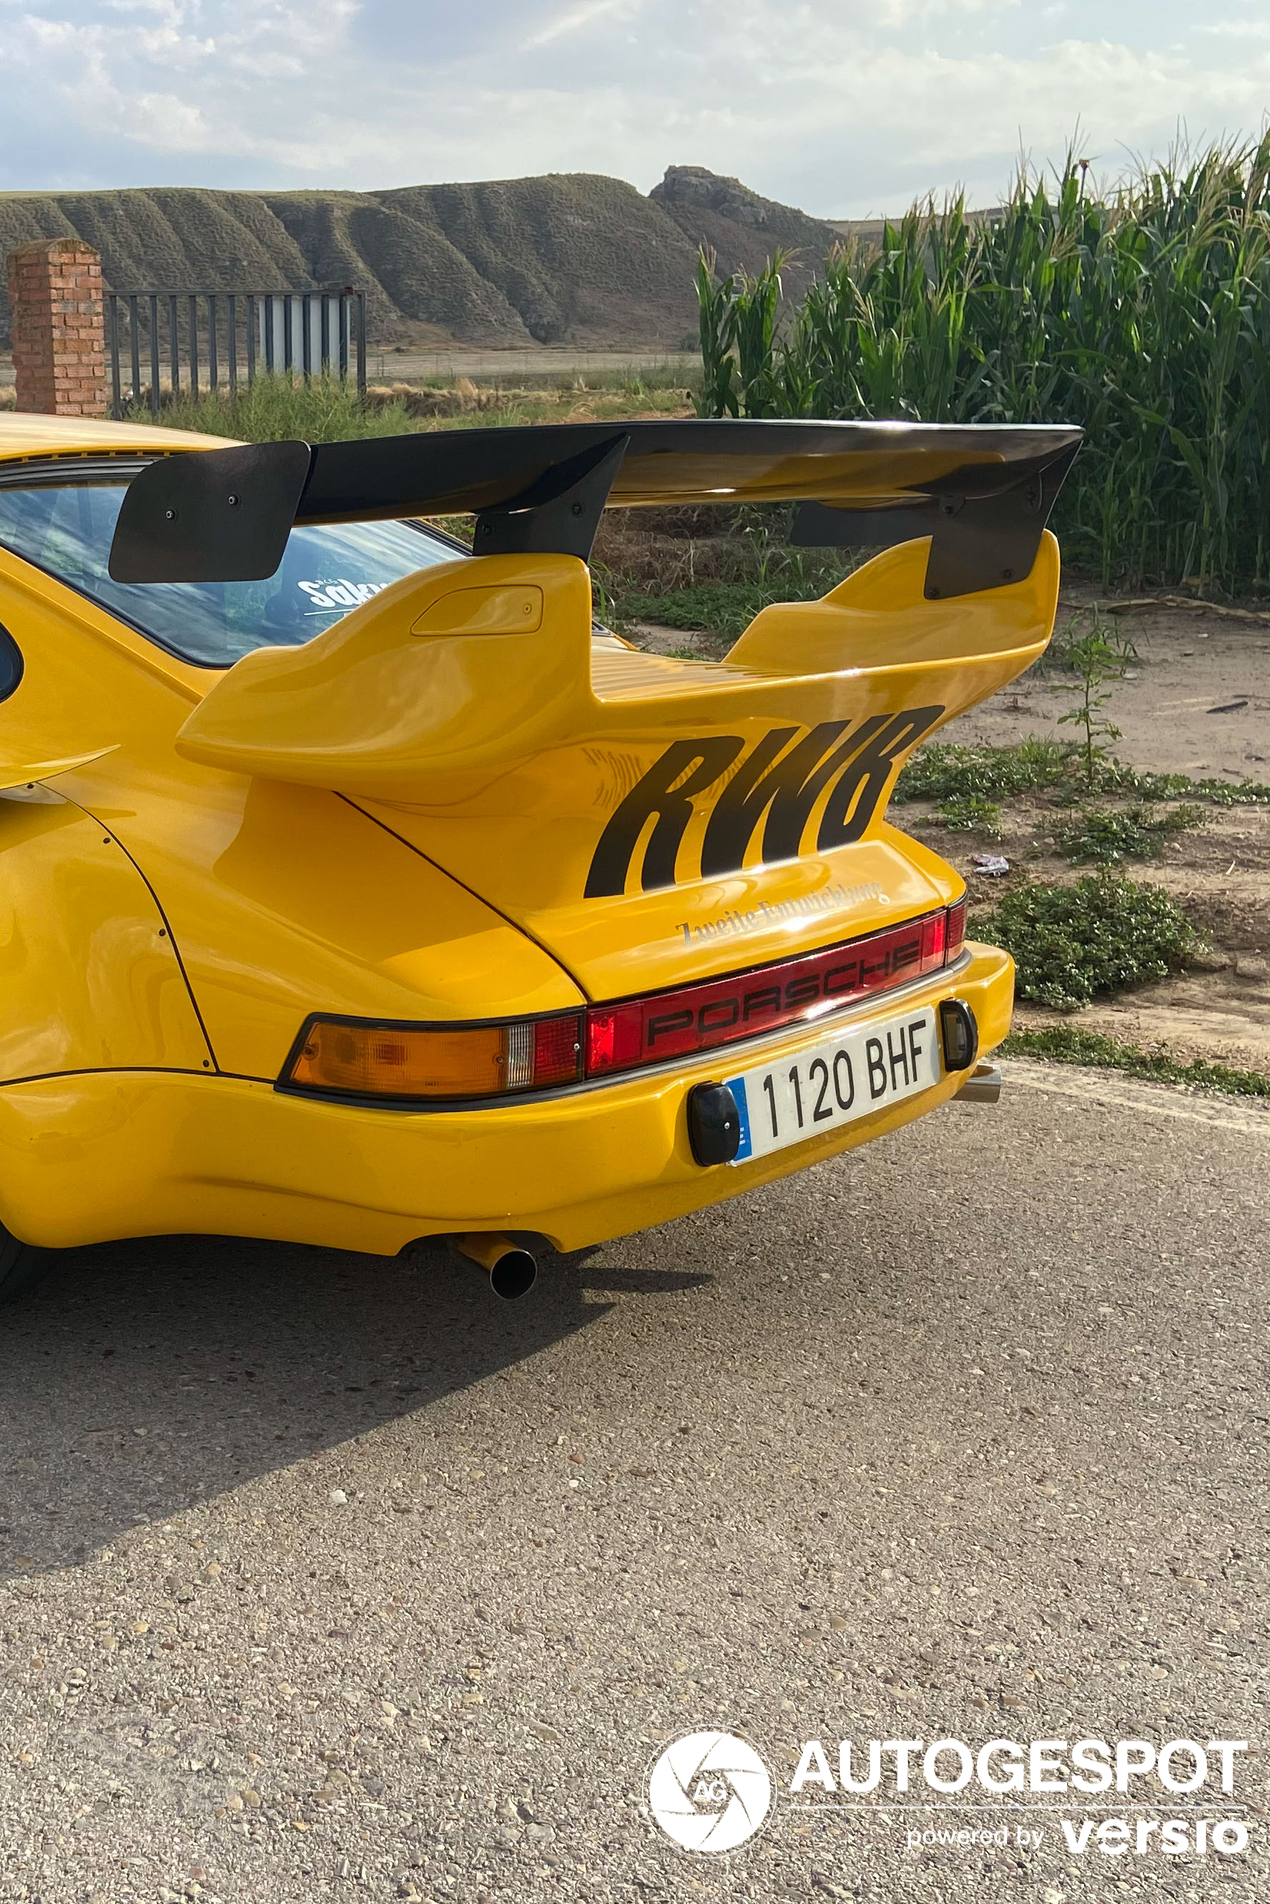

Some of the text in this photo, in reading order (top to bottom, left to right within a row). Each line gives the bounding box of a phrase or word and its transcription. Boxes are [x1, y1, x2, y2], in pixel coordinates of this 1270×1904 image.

[583, 704, 946, 899] RWB
[675, 880, 891, 948] Zweite Entwicklung
[647, 940, 920, 1046] PORSCHE
[763, 1019, 927, 1138] 1120 BHF
